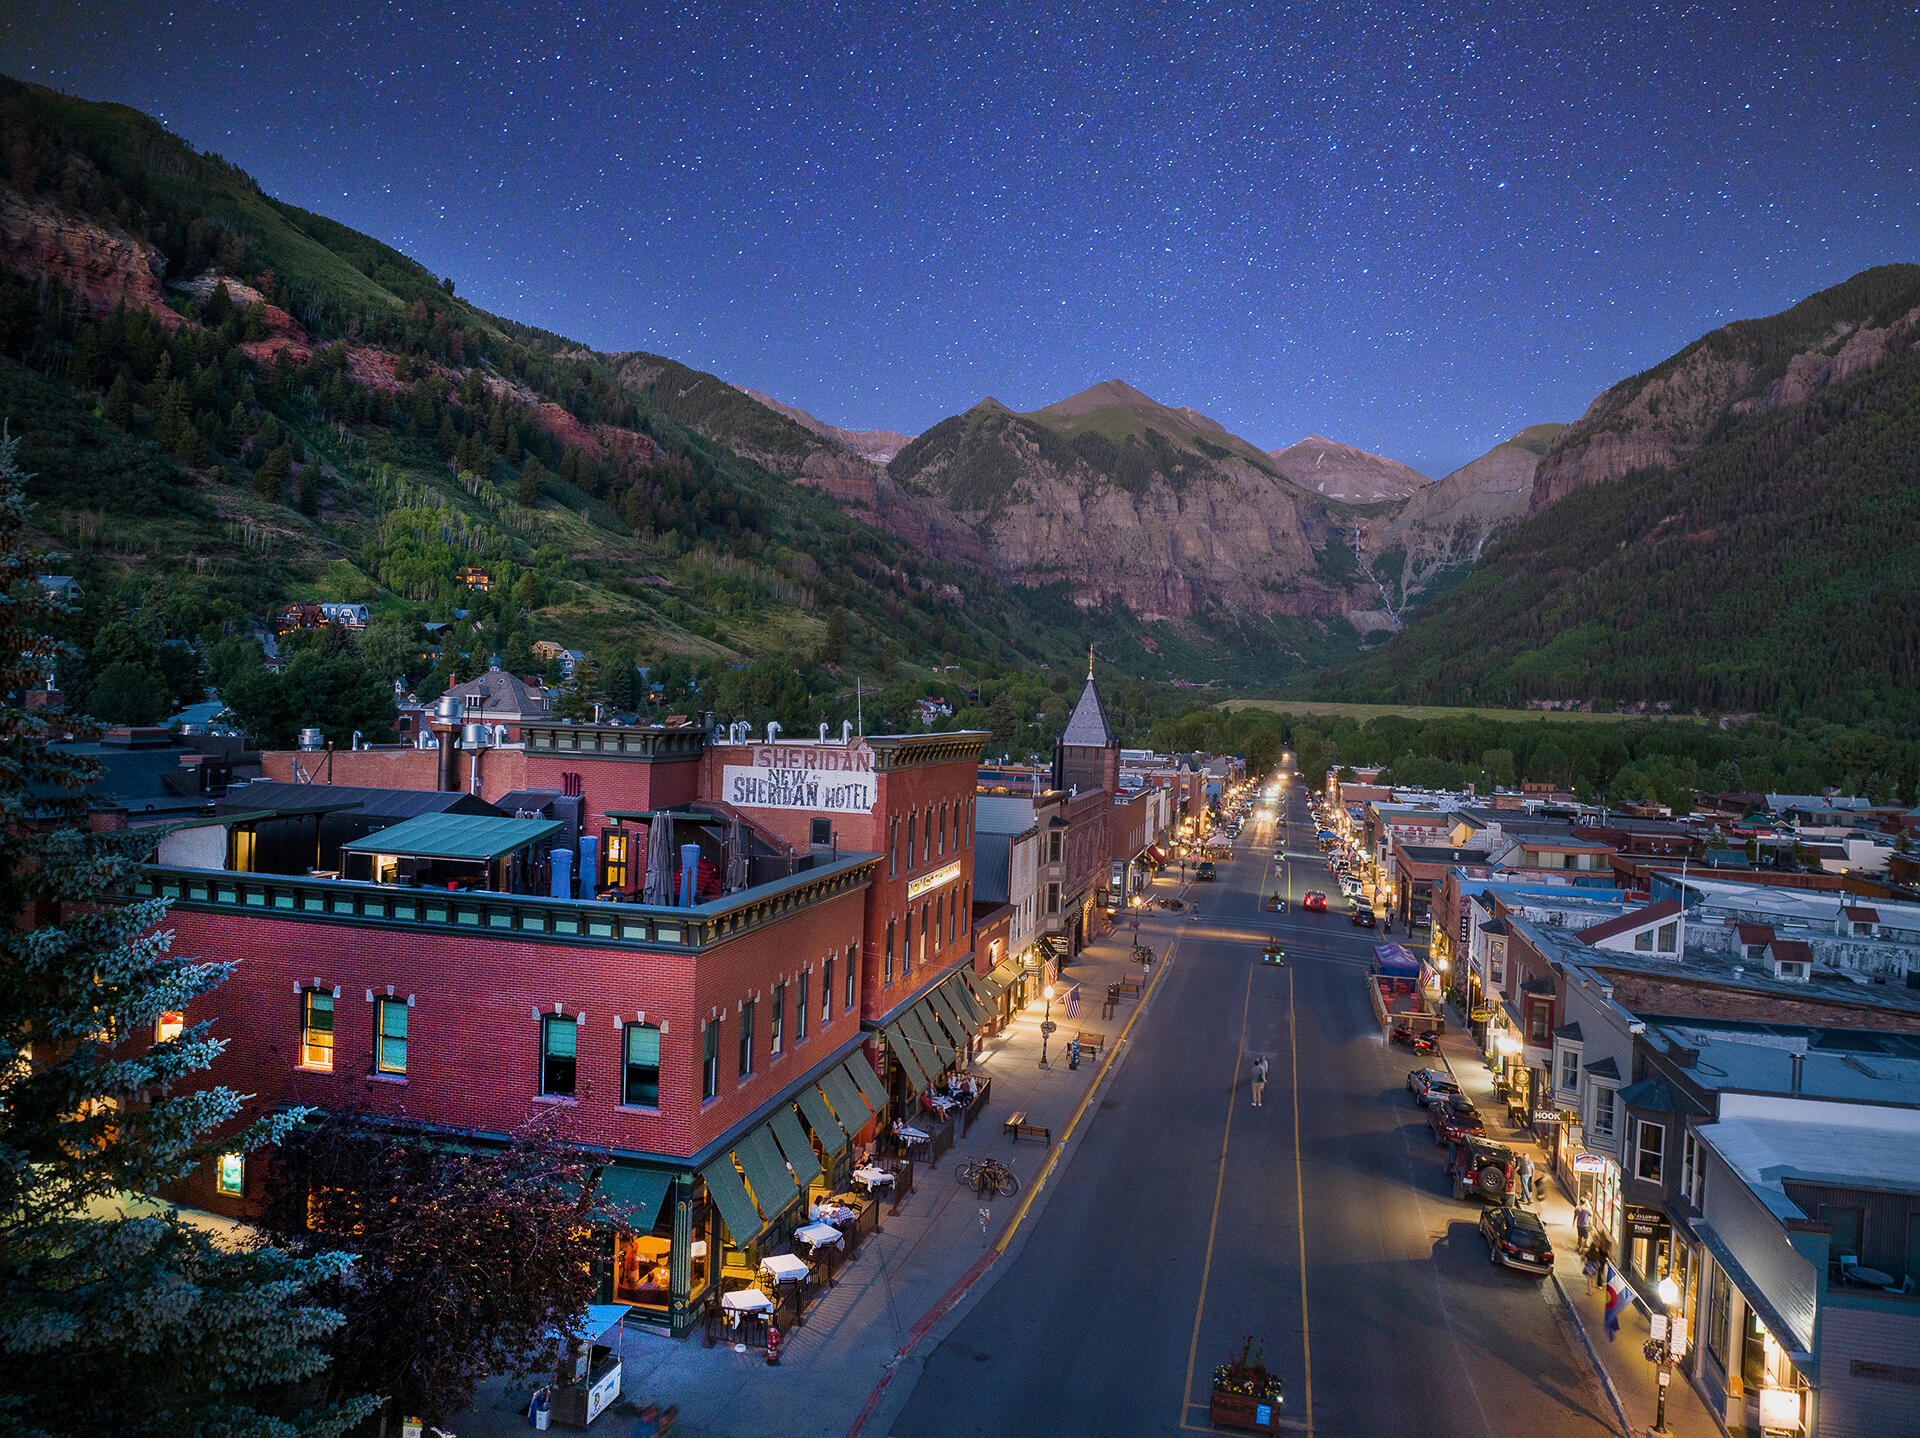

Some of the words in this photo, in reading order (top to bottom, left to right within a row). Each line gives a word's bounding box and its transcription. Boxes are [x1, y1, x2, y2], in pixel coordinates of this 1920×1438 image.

[759, 748, 870, 772] SHERIDAN
[768, 769, 809, 788] NEW
[734, 776, 818, 806] SHERIDAN
[825, 783, 871, 810] HOTEL
[1534, 1111, 1561, 1120] HOOK
